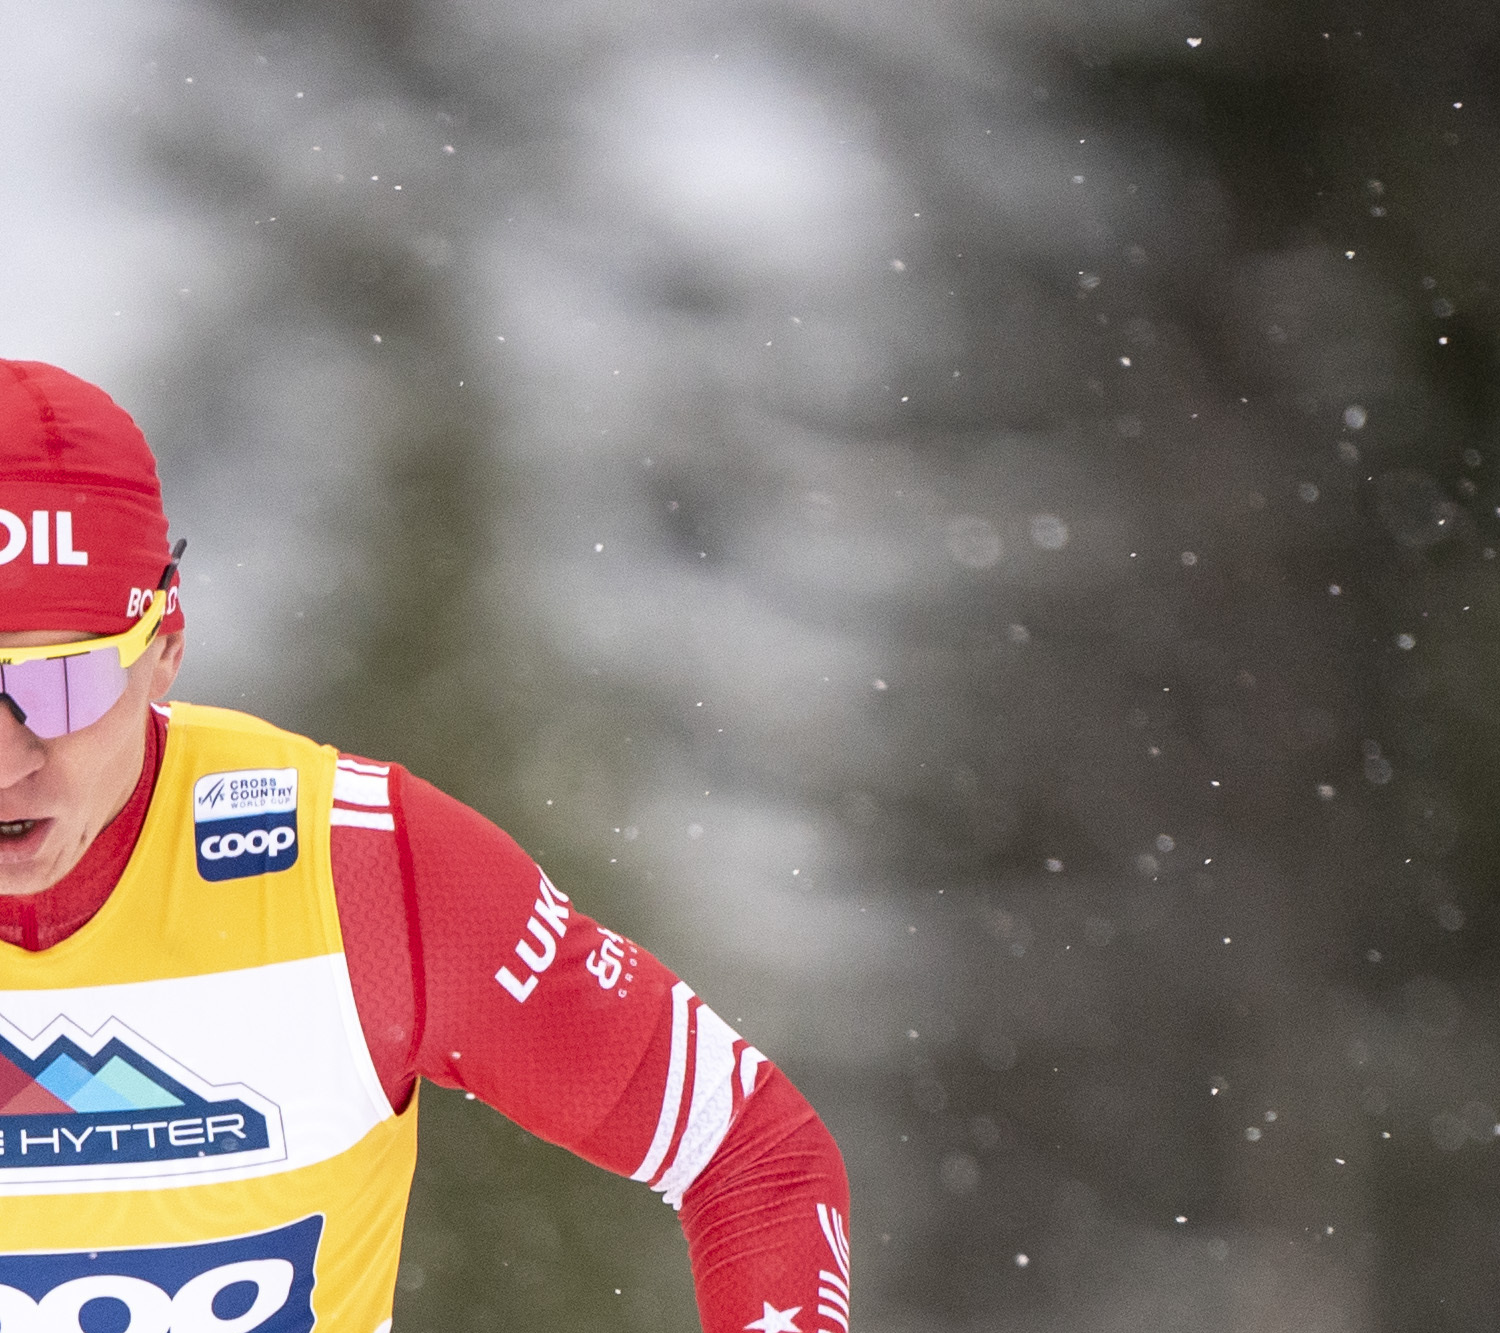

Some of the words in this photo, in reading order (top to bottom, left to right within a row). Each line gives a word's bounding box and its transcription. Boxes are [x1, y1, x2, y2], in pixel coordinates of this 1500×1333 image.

[230, 778, 277, 791] CROSS
[230, 785, 294, 802] COUNTRY
[20, 1113, 247, 1155] HYTTER
